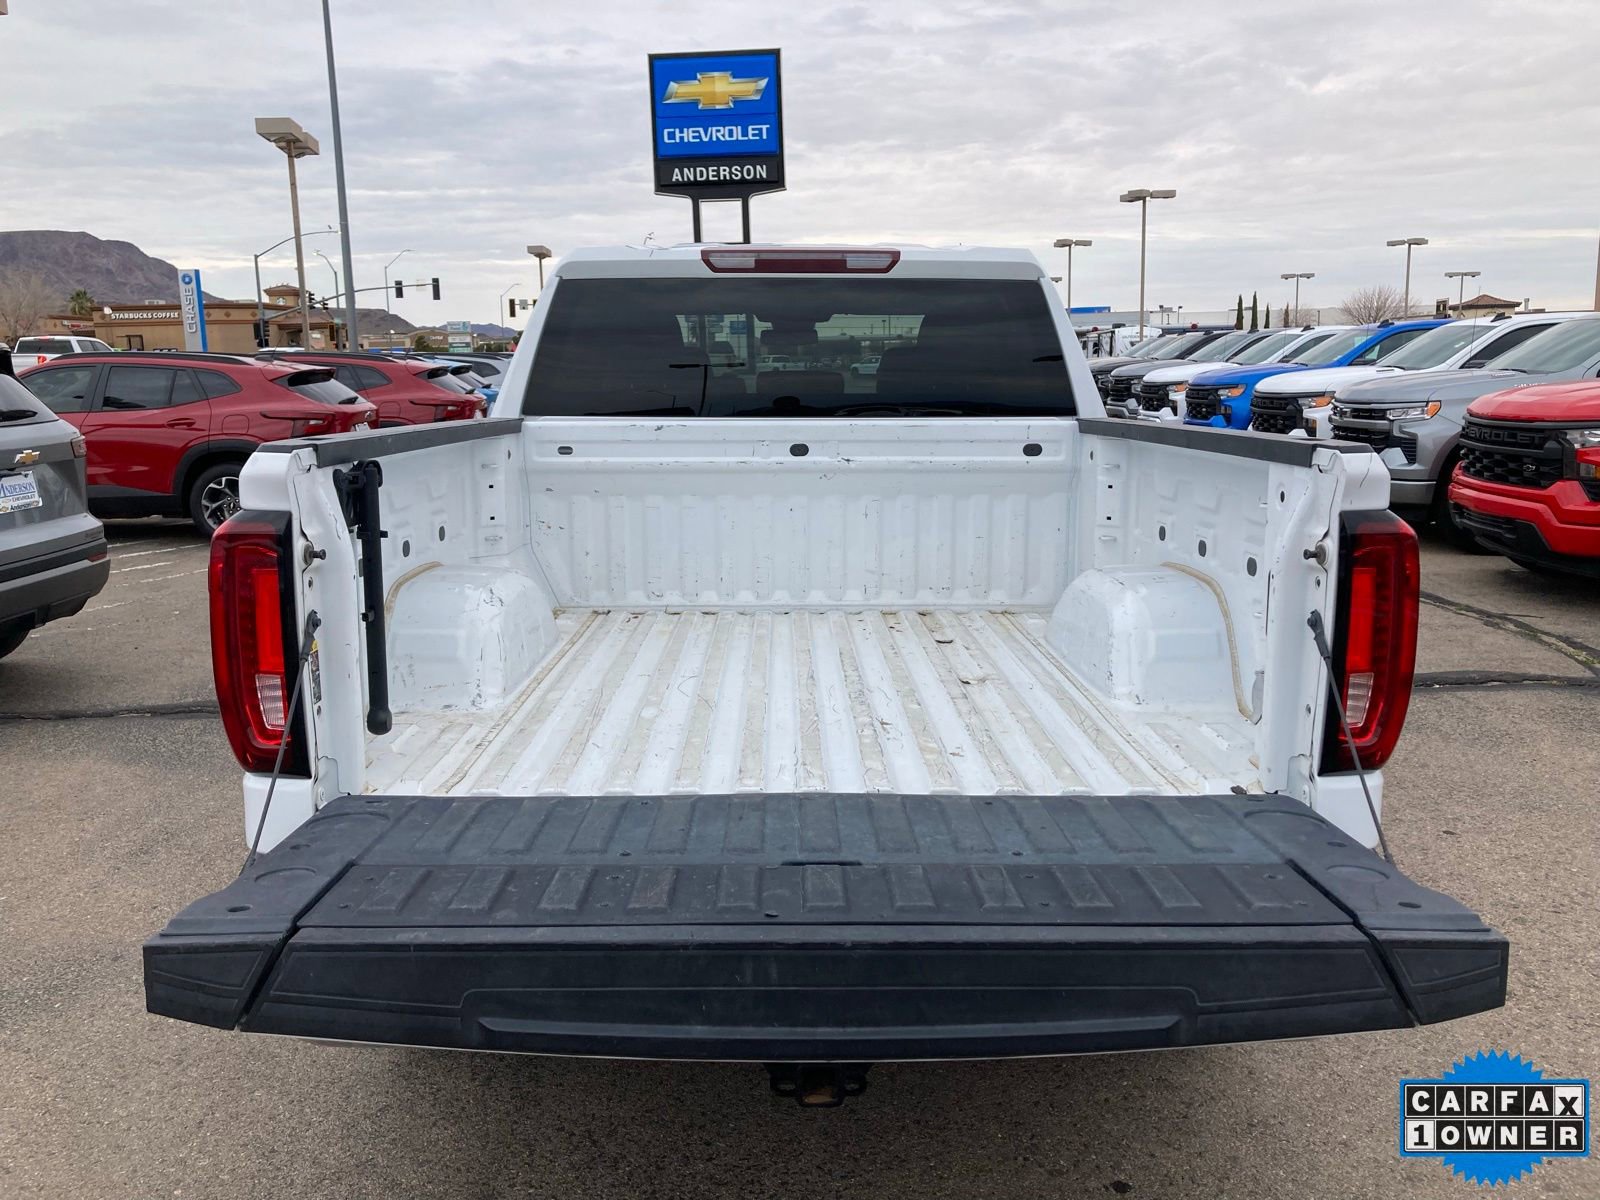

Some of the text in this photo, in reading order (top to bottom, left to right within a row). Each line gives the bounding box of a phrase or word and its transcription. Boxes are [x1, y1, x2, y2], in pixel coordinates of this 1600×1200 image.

[663, 125, 770, 143] CHEVROLET
[672, 164, 767, 182] ANDERSON
[111, 311, 179, 320] STARBUCKS COFFEE
[184, 287, 197, 333] CHASE
[0, 481, 35, 497] ANDERSON
